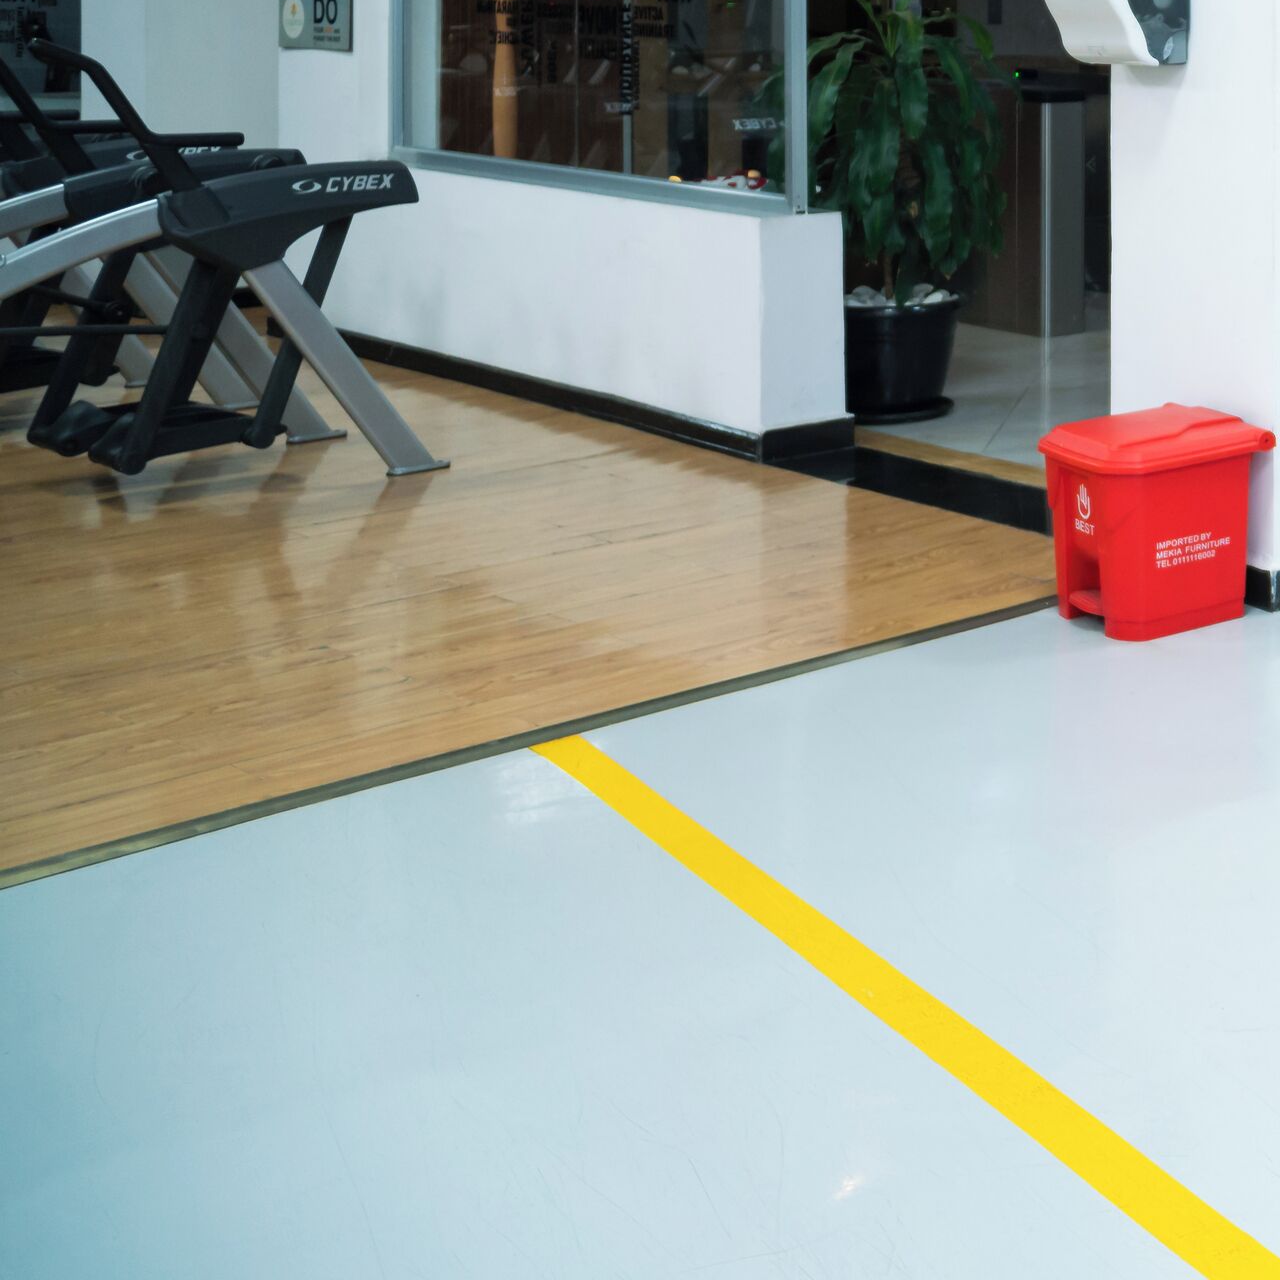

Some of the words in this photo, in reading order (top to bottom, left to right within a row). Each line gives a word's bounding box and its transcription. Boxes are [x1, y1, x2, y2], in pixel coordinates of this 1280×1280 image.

[326, 173, 394, 193] CYBEX
[1075, 519, 1095, 536] BEST
[1156, 535, 1199, 550] IMPORTED
[1201, 532, 1211, 541] BY
[1156, 548, 1182, 560] MEKIA
[1186, 537, 1231, 554] FURNITURE
[1156, 560, 1171, 568] TEL
